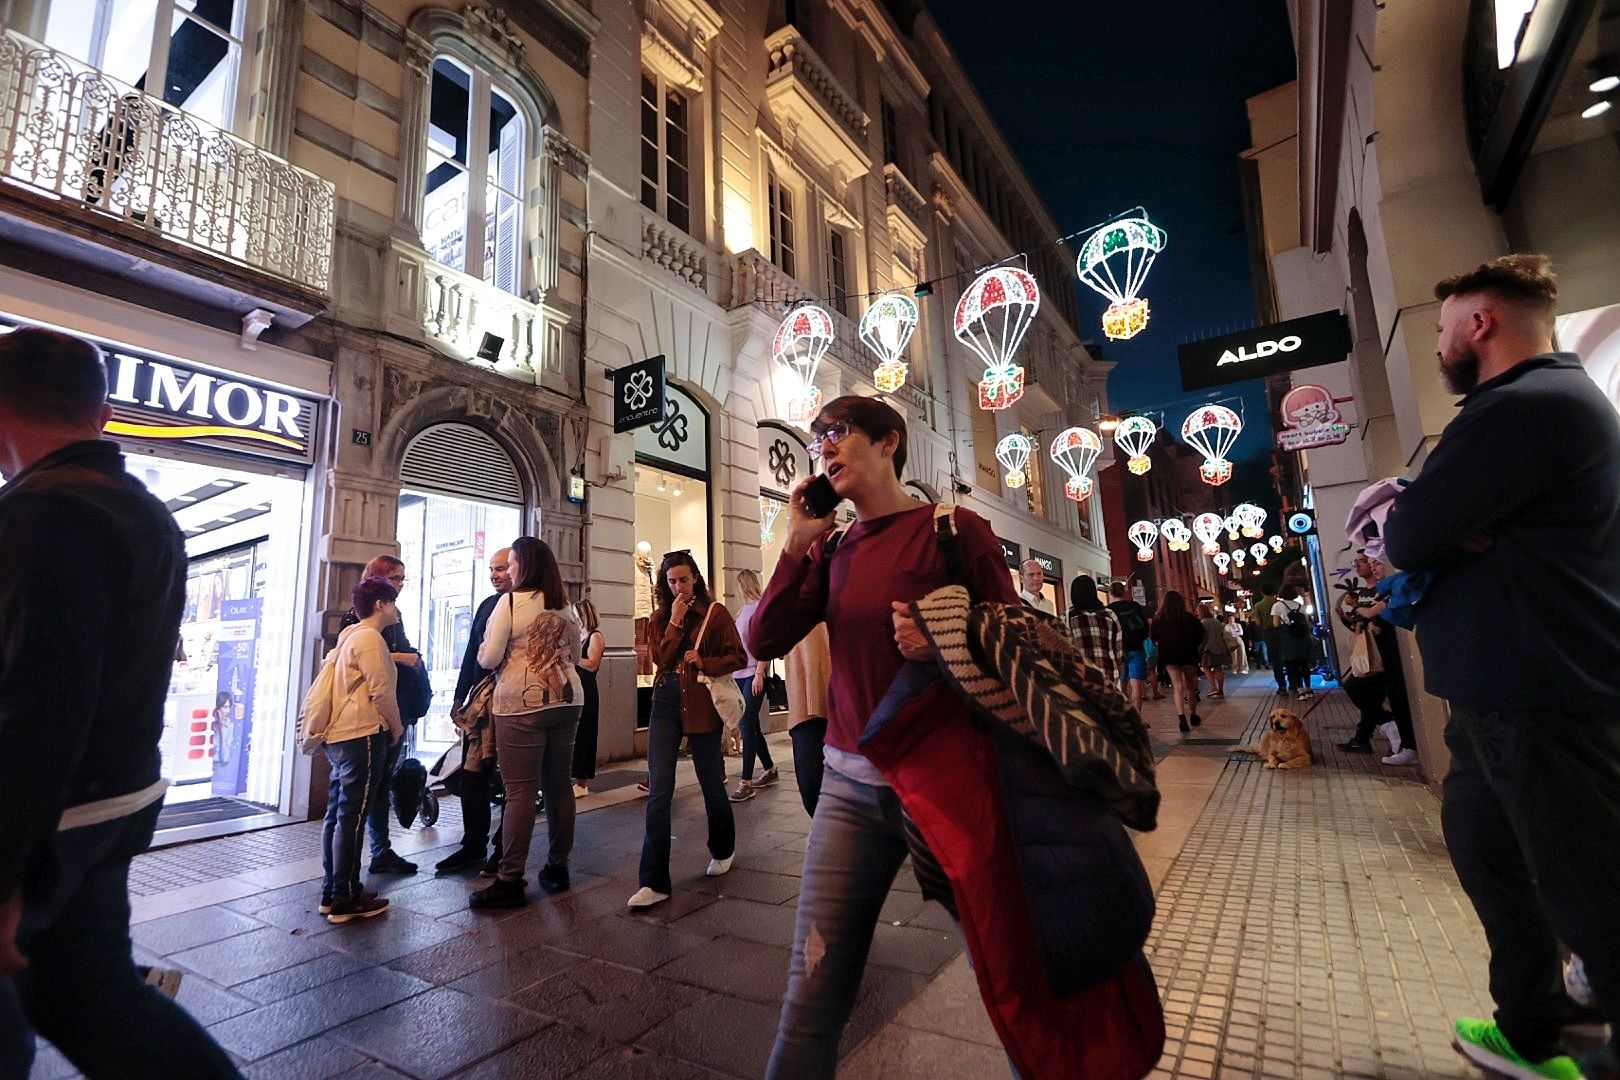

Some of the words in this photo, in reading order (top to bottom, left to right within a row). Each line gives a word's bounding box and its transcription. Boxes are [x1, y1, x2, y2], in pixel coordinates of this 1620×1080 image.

[1216, 335, 1302, 367] ALDO
[102, 350, 305, 438] IMOR
[356, 432, 368, 445] 25
